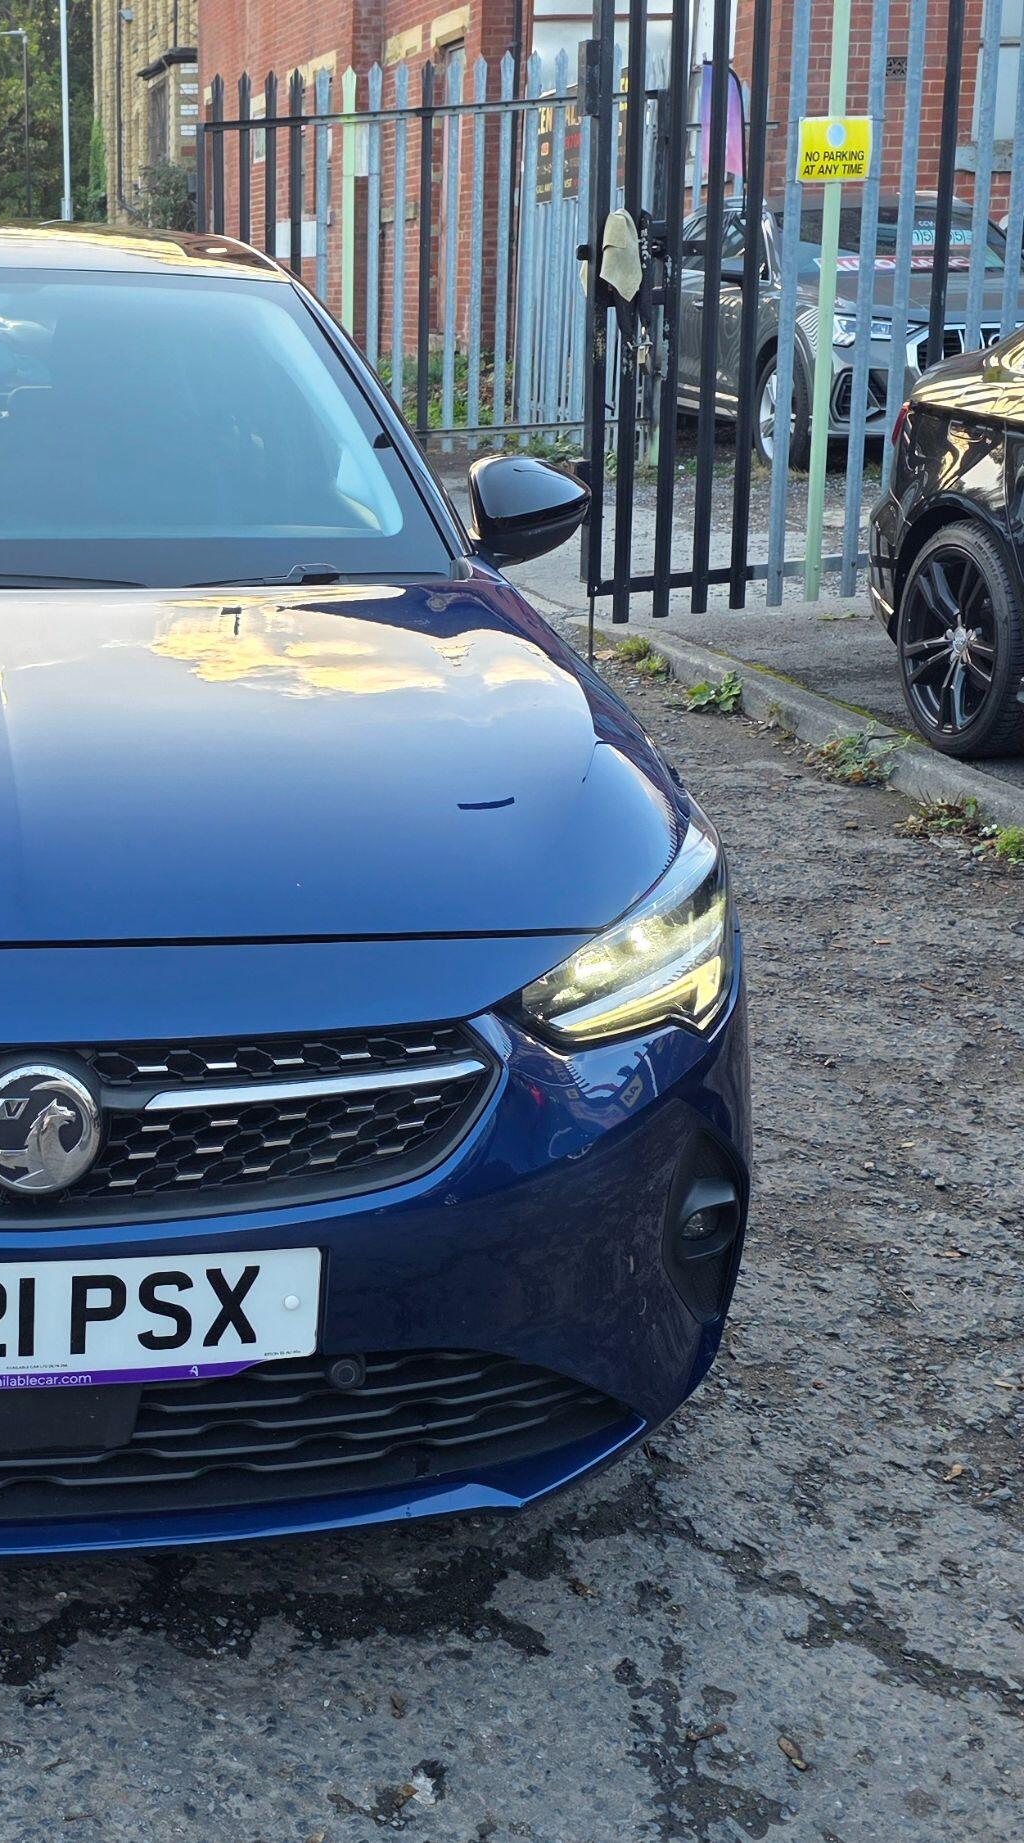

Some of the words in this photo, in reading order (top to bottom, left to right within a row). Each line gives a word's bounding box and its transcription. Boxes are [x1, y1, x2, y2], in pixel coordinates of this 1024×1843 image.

[805, 151, 820, 162] NO
[823, 150, 865, 161] PARKING
[803, 164, 815, 175] AT
[818, 164, 839, 175] ANY
[842, 163, 863, 174] TIME
[70, 1265, 260, 1354] PSX
